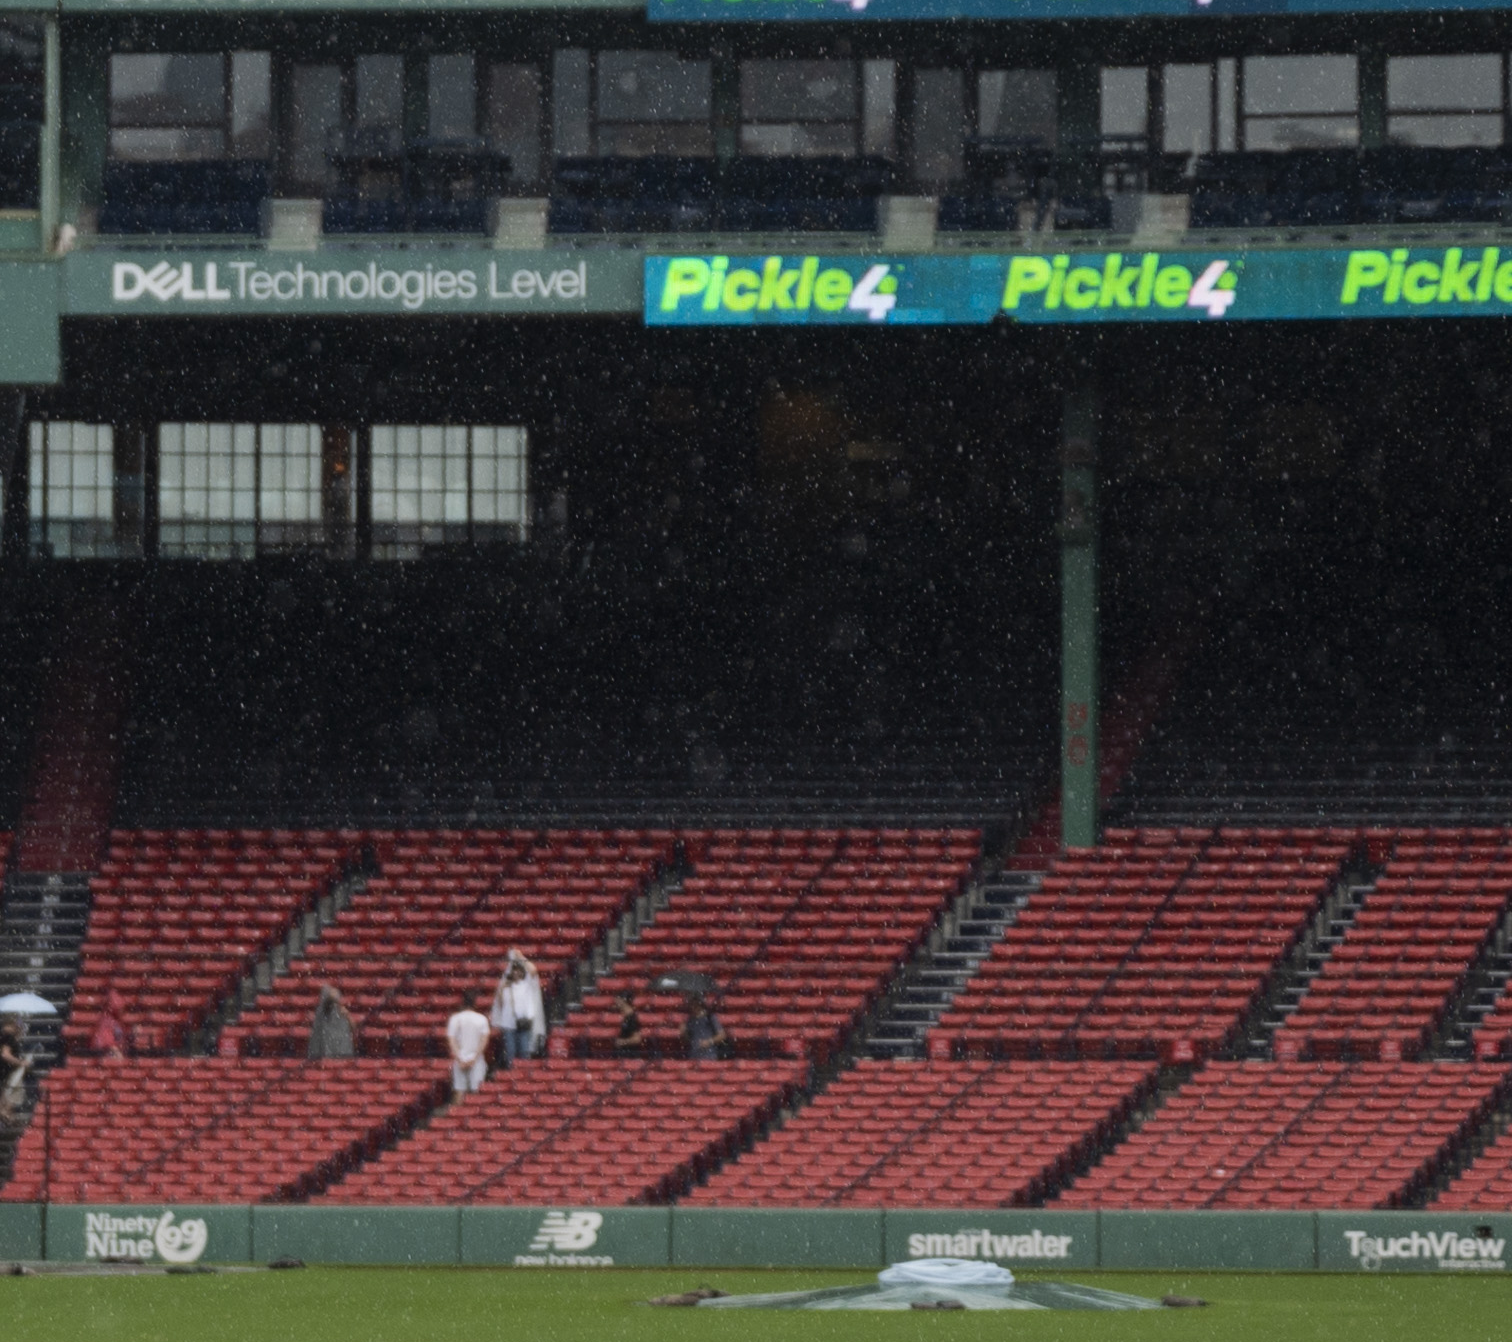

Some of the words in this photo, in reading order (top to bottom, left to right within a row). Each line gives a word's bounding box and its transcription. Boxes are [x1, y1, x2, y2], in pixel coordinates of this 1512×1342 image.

[112, 262, 230, 302] DELL
[230, 261, 476, 310] Technologies
[488, 259, 588, 300] Level
[660, 257, 898, 320] Pickle4
[1002, 254, 1237, 317] Pickle4
[86, 1212, 158, 1235] Ninety
[86, 1234, 154, 1258] Nine
[909, 1229, 1072, 1259] smartwater
[1344, 1231, 1505, 1260] TouchView
